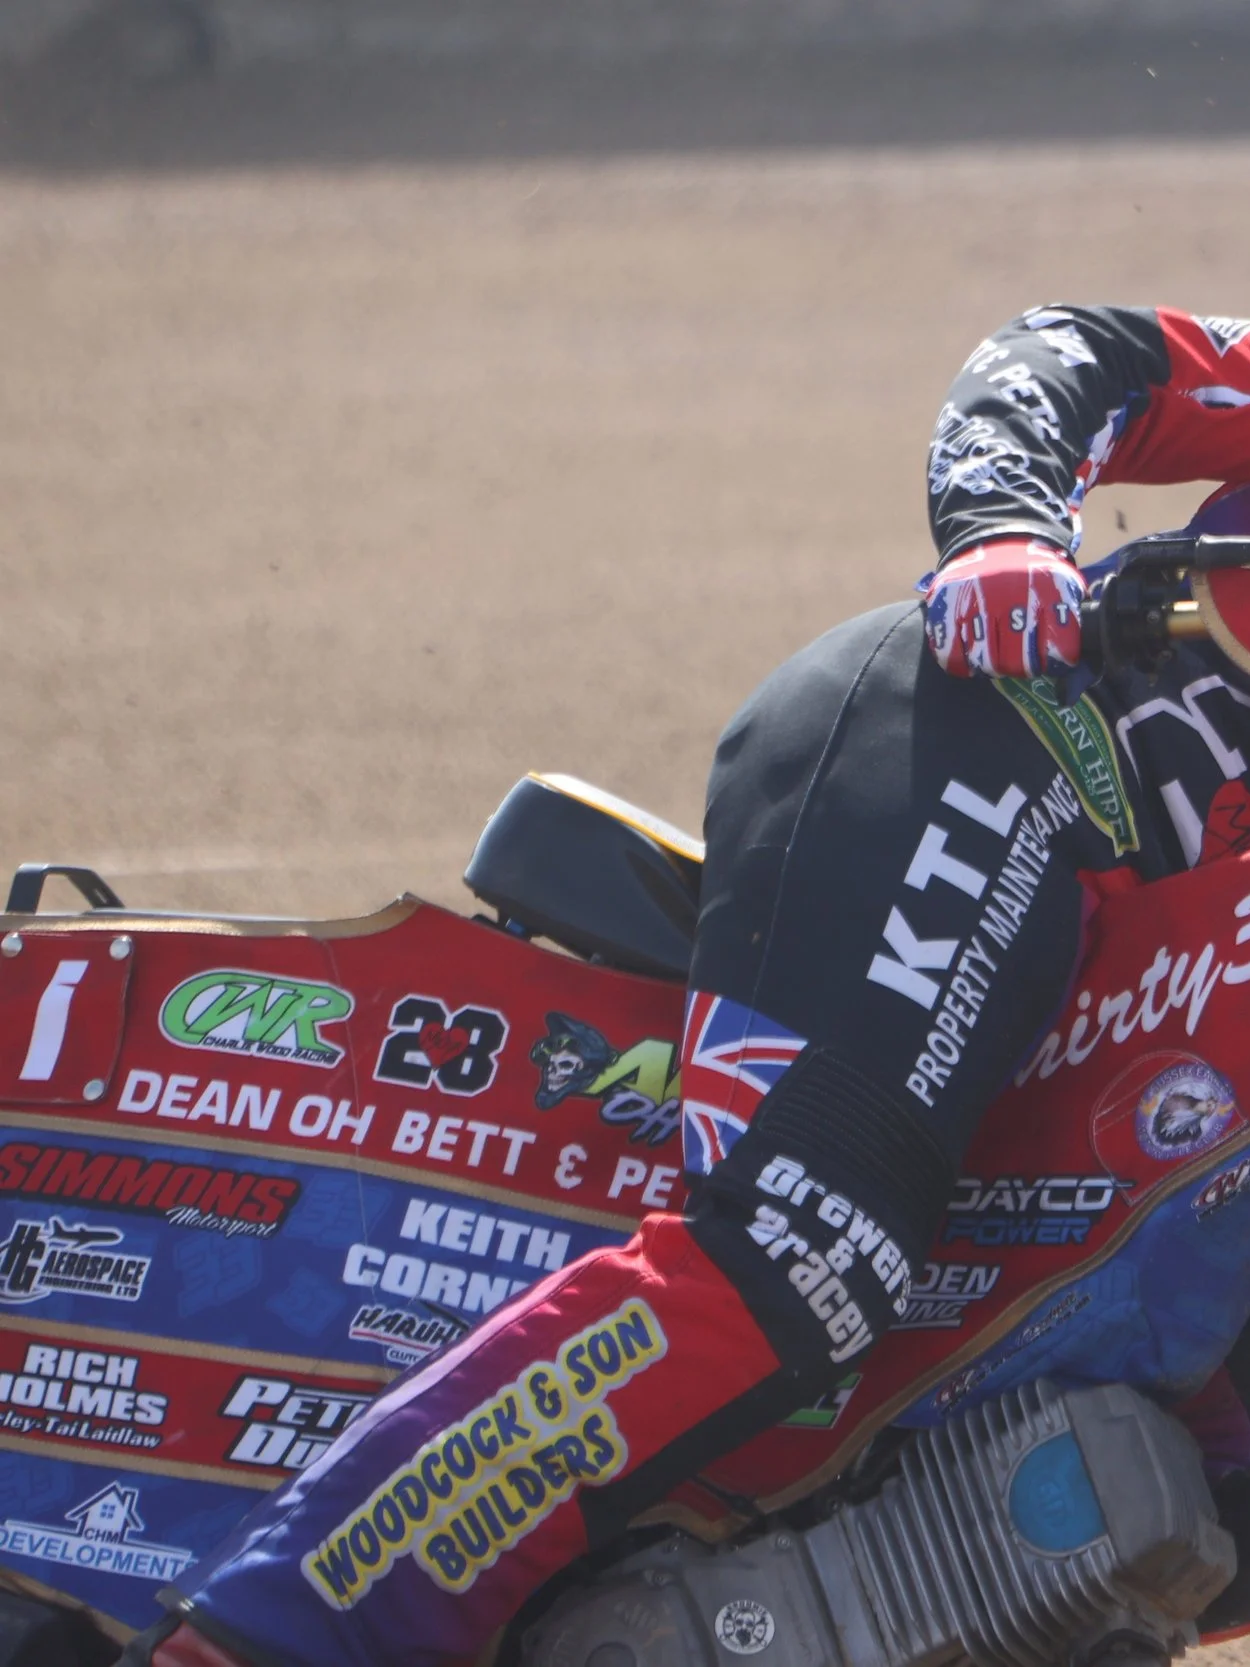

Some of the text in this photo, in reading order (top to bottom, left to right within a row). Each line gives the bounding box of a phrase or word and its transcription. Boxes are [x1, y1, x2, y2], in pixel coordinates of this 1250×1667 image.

[161, 970, 351, 1052] CWR
[374, 994, 509, 1096] 28
[905, 936, 998, 1109] PROPERTY
[117, 1070, 284, 1132] DEAN
[288, 1095, 375, 1143] OH
[392, 1110, 536, 1176] BETT
[0, 1143, 297, 1222] SIMMONS
[42, 1250, 147, 1286] AEROSPACE
[401, 1198, 570, 1272] KEITH
[23, 1344, 138, 1387] RICH
[78, 1421, 161, 1449] Laidlaw
[314, 1311, 656, 1600] WOODCOCK & SON
[84, 1527, 120, 1543] CHM
[426, 1413, 617, 1581] BUILDERS
